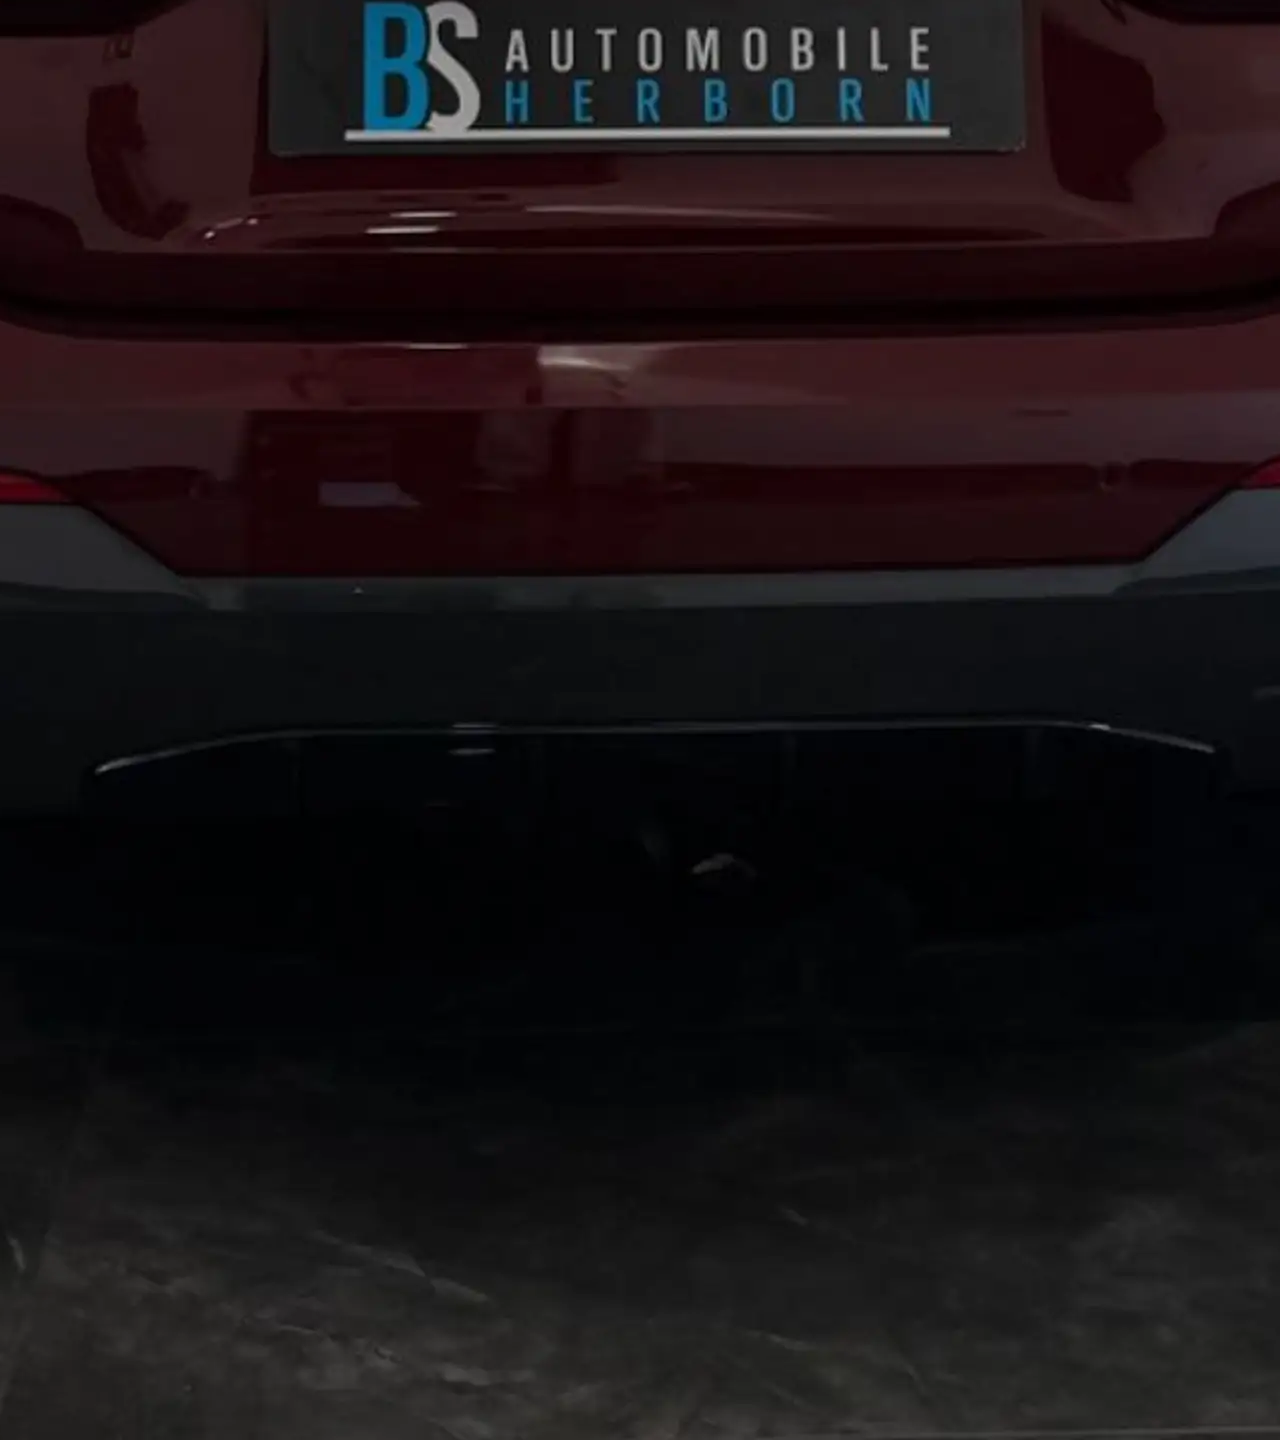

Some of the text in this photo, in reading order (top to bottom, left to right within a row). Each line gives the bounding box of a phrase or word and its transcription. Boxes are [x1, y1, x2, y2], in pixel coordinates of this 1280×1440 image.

[363, 0, 481, 131] BS
[505, 27, 930, 72] AUTOMOBILE
[505, 78, 931, 123] HERBORN
